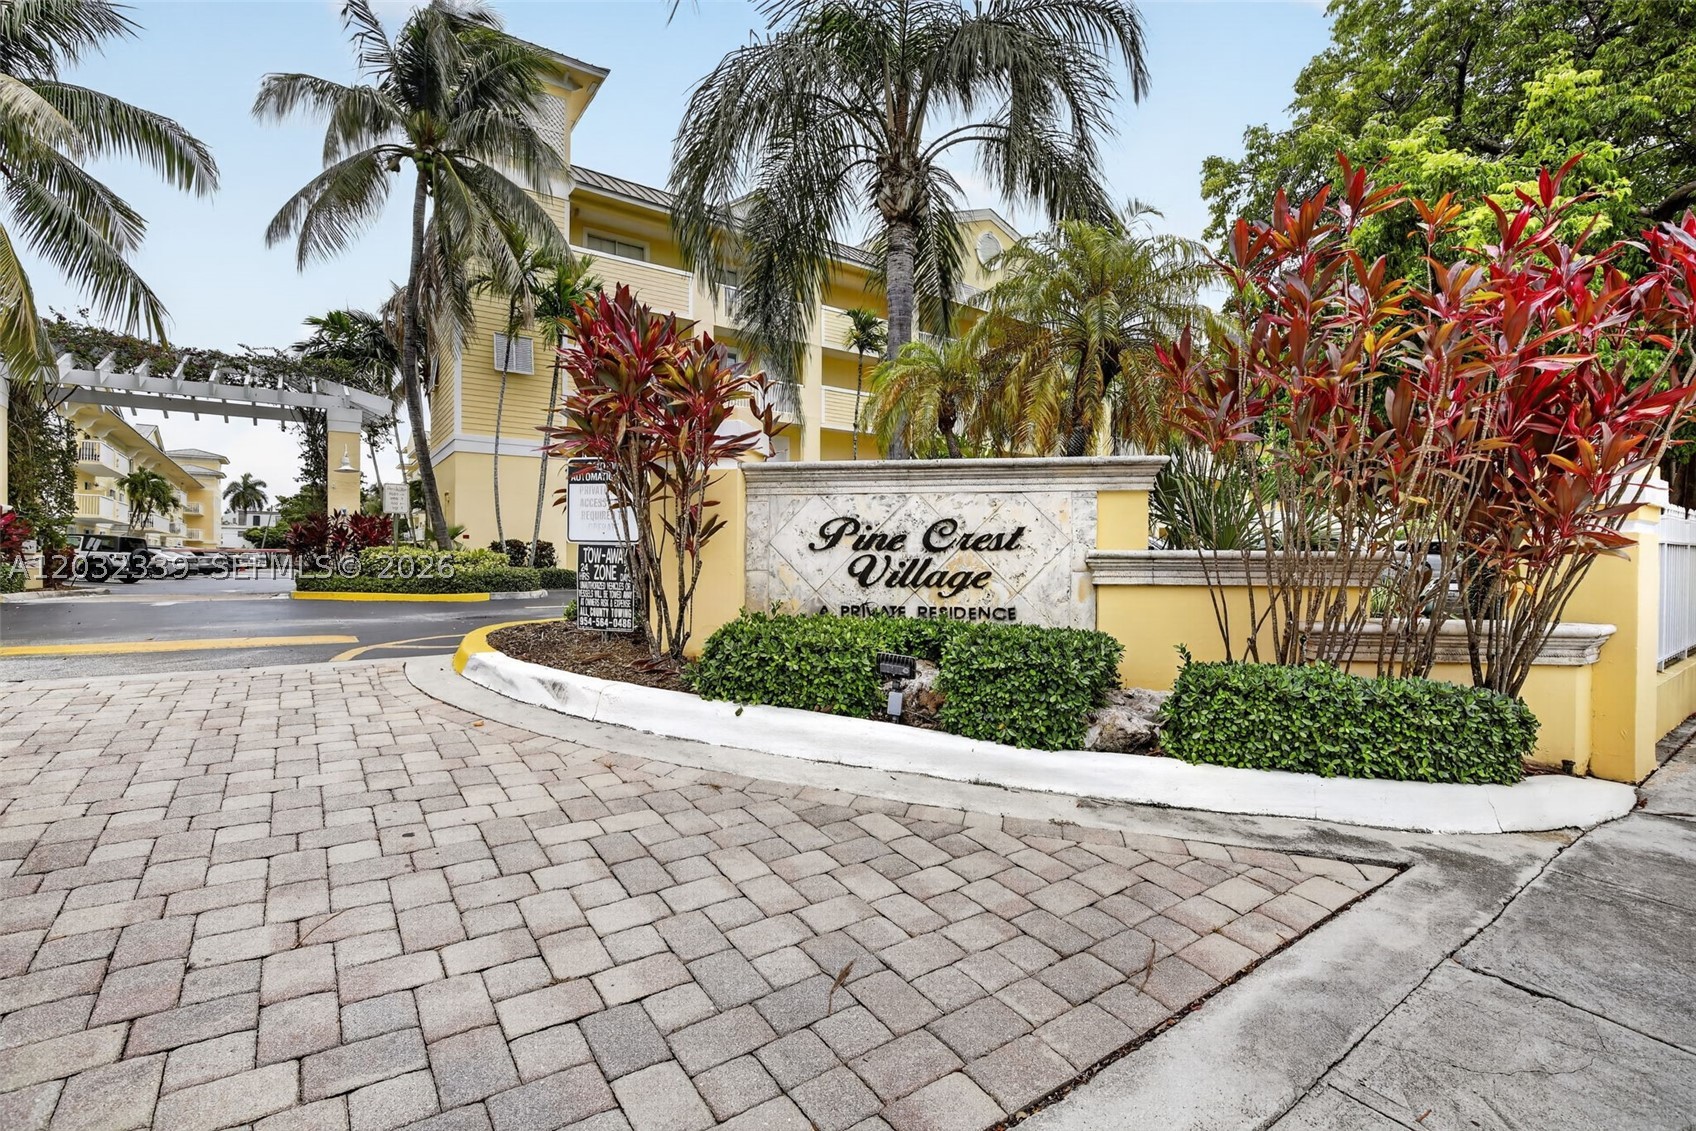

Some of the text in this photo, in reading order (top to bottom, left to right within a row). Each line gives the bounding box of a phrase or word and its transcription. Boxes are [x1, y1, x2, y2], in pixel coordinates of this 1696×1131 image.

[580, 498, 607, 507] ACCESS
[581, 510, 613, 521] REQUIRE
[808, 516, 1026, 552] Pine Crest
[593, 564, 617, 580] ZONE
[848, 554, 992, 599] Village
[840, 605, 906, 618] PRIVATE
[918, 606, 1016, 621] RESIDENCE
